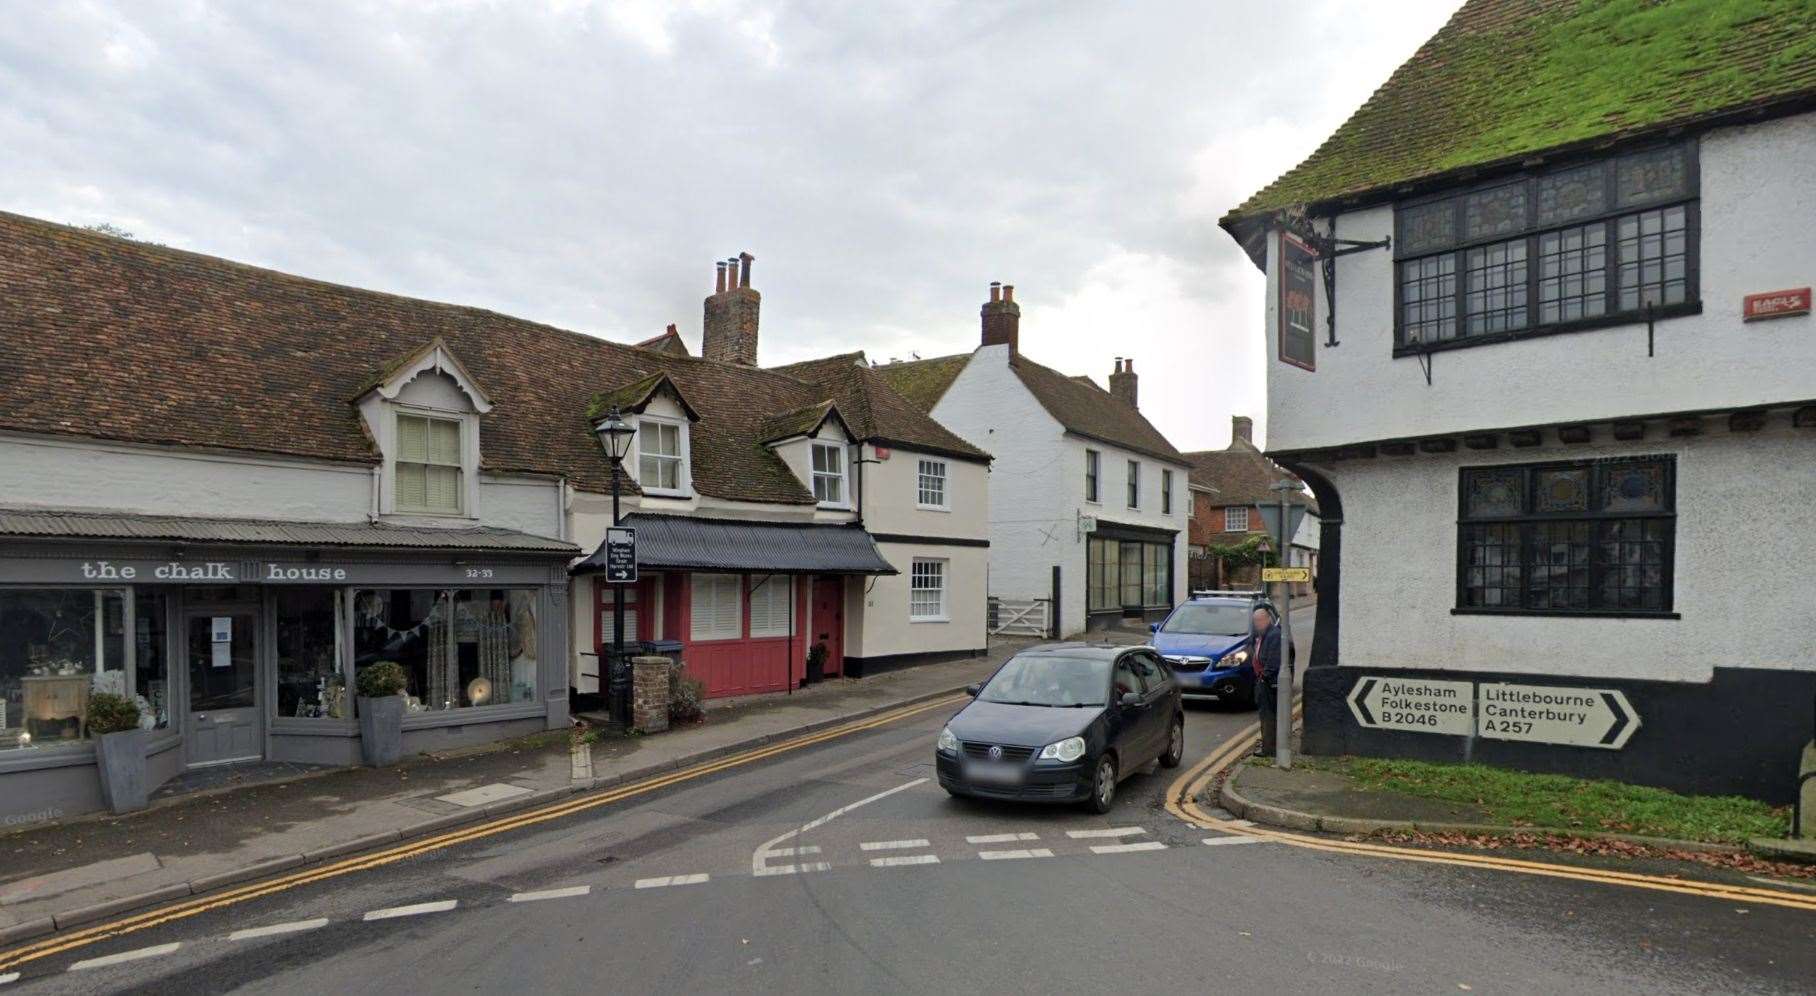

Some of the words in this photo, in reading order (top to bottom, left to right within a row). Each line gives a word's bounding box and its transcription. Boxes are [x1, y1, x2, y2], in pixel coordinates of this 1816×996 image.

[81, 561, 136, 579] the
[155, 562, 234, 580] chalk
[267, 563, 346, 580] house
[1382, 682, 1457, 698] Aylesham
[1486, 688, 1595, 707] Littlebourne
[1381, 697, 1467, 714] Folkestone
[1382, 711, 1391, 723] B
[1394, 712, 1437, 726] 2046
[1485, 704, 1587, 725] Canterbury
[1485, 719, 1496, 731] A
[1500, 720, 1533, 734] 257
